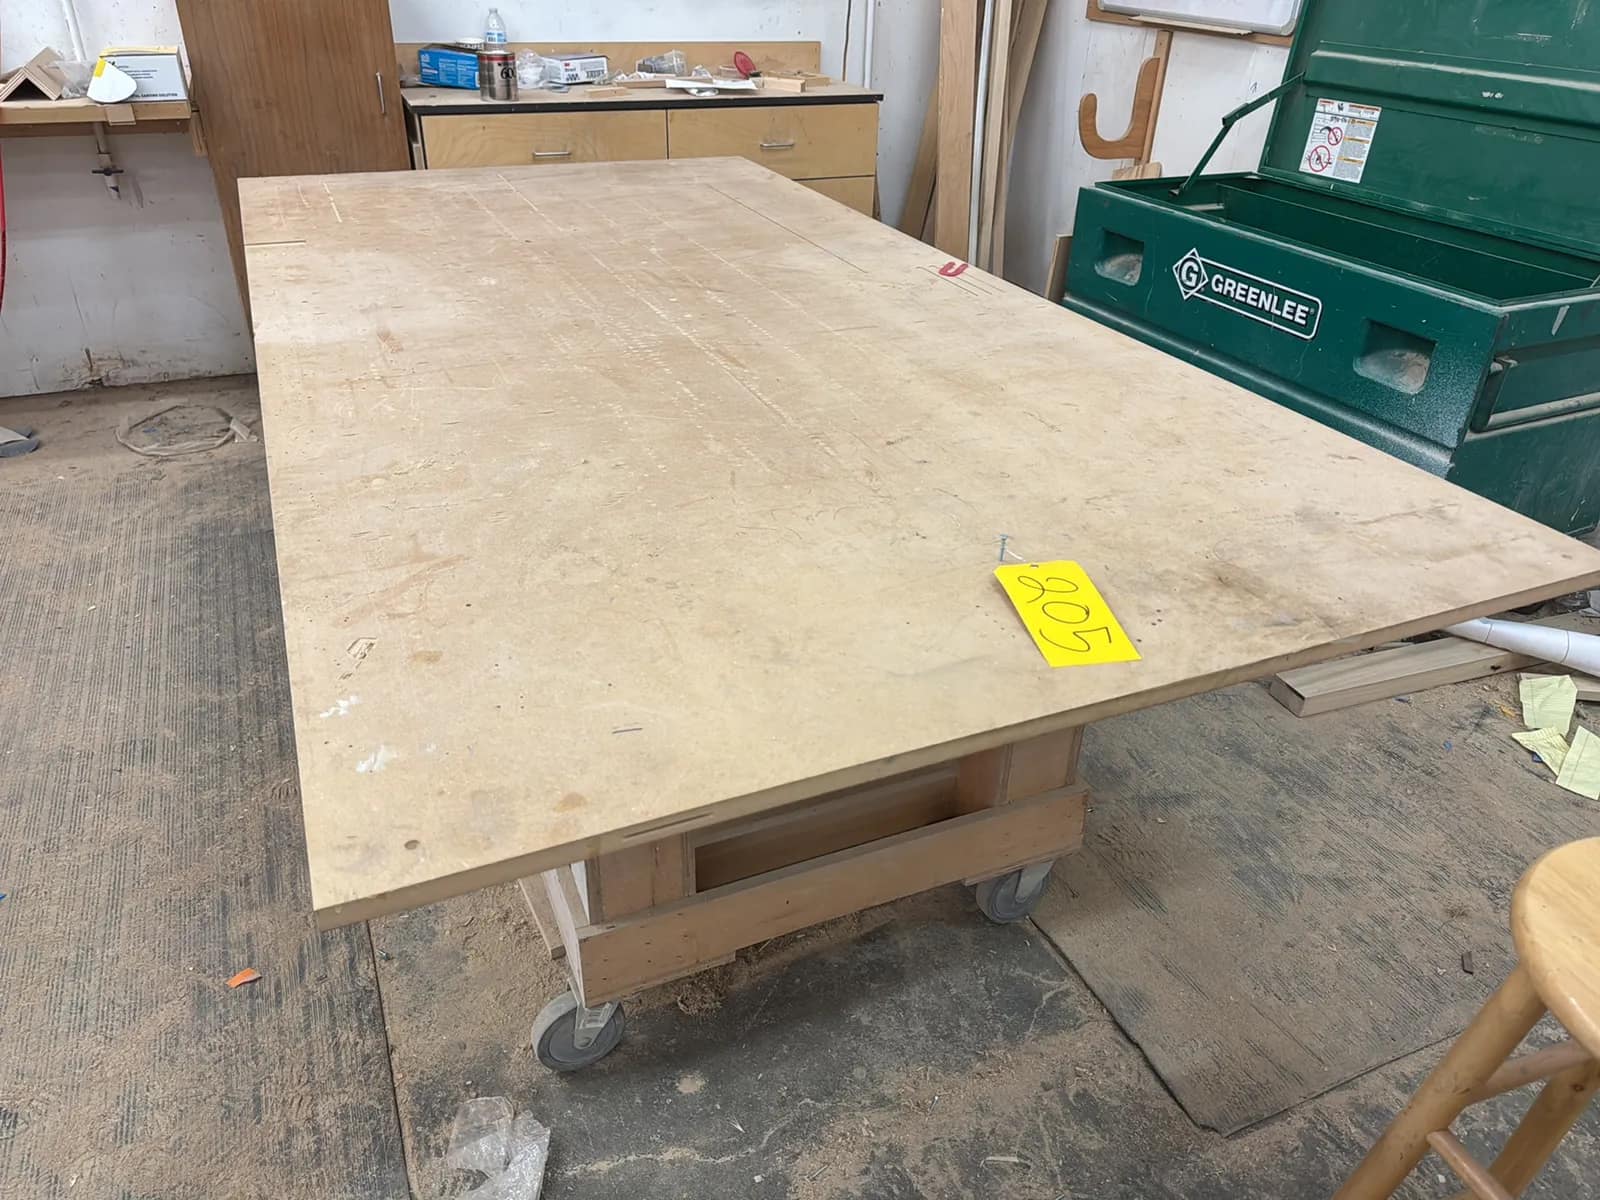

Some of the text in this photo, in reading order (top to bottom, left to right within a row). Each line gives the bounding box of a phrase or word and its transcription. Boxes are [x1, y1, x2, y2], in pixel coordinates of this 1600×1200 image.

[1181, 260, 1199, 287] G
[1211, 274, 1310, 326] GREENLEE
[1017, 575, 1112, 653] 205
